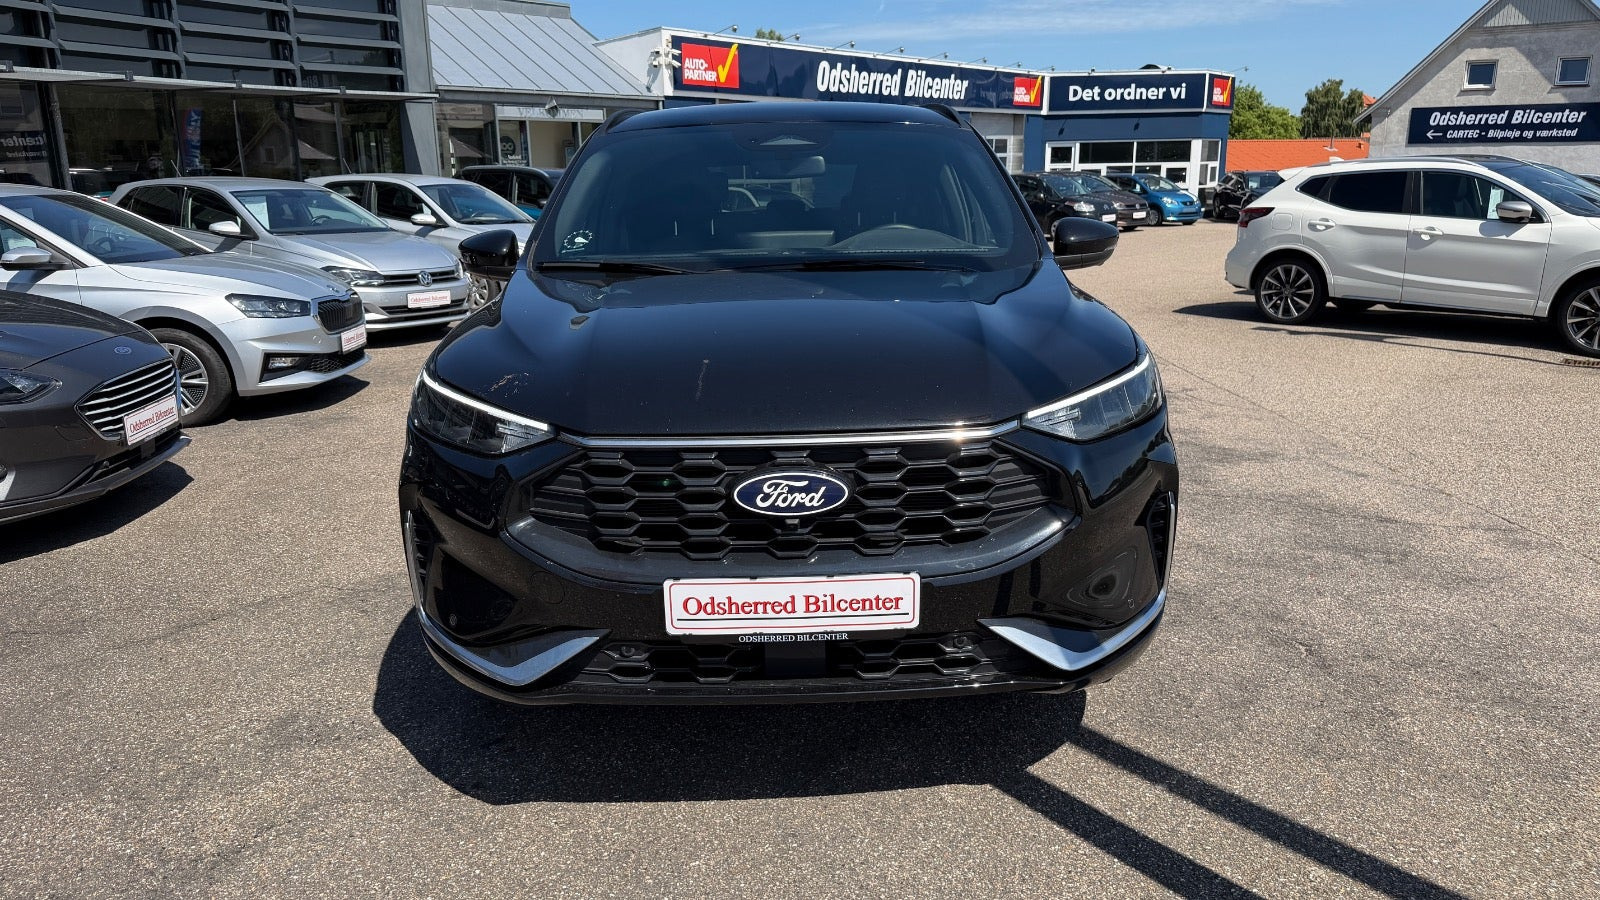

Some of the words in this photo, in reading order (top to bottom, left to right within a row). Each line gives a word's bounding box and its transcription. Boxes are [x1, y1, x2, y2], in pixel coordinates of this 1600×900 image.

[684, 58, 708, 70] AUTO-
[684, 69, 717, 82] PARTNER
[816, 60, 902, 96] Odsherred
[904, 69, 969, 100] Bilcenter
[1068, 85, 1100, 102] Det
[1104, 83, 1166, 101] ordner
[1170, 82, 1187, 100] vi
[1429, 110, 1509, 127] Odsherred
[1511, 108, 1587, 125] Bilcenter
[1446, 129, 1480, 139] CARTEC
[1487, 129, 1520, 140] Bilpleje
[1522, 130, 1533, 139] og
[1536, 128, 1578, 138] værksted
[755, 479, 826, 508] Ford
[682, 595, 797, 616] Odsherred
[803, 593, 904, 614] Bilcenter
[738, 634, 795, 643] ODSHERRED
[797, 633, 849, 642] BILCENTER
